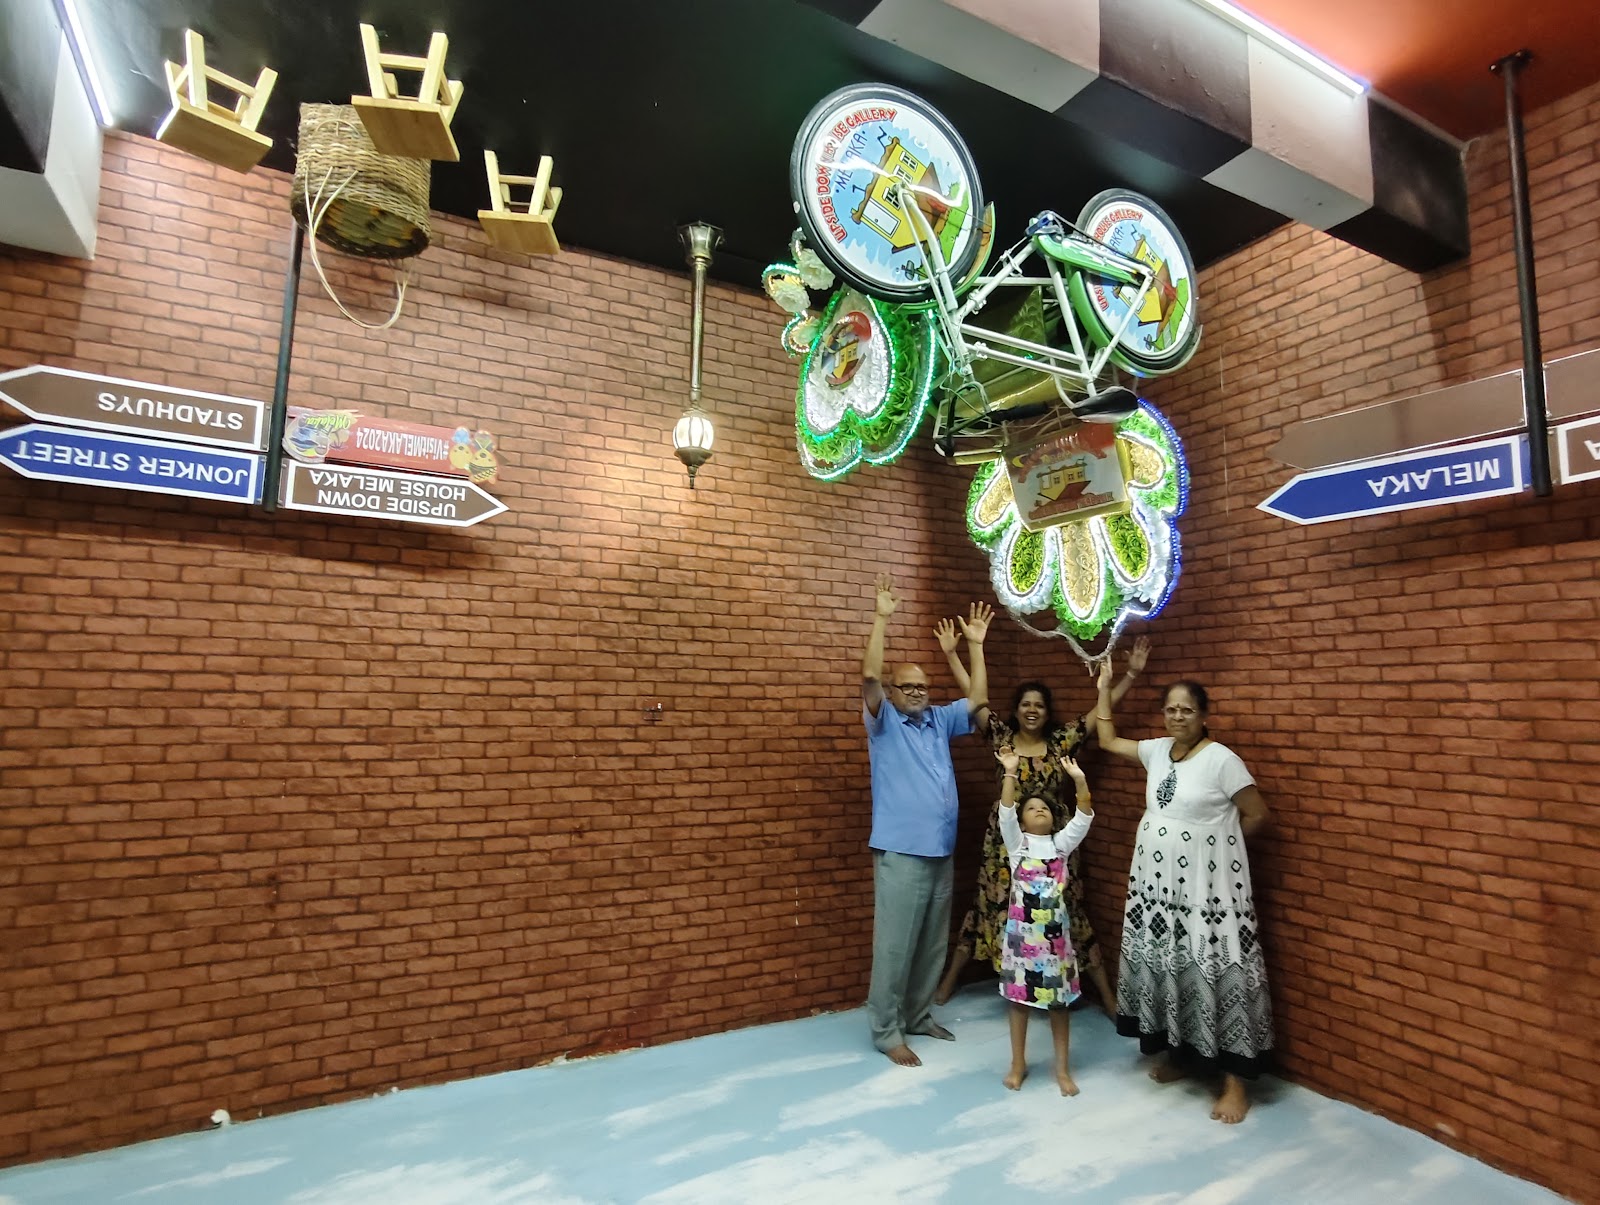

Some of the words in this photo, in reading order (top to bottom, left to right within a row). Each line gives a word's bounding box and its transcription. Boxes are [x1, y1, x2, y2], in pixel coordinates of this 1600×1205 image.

[820, 195, 848, 243] UPSIDE
[846, 107, 897, 128] GALLERY
[836, 133, 868, 192] MEAKA
[1110, 208, 1143, 223] GALLERY
[98, 392, 244, 430] STADHUYS
[305, 413, 351, 430] Melaka
[11, 440, 131, 471] STREET
[356, 427, 450, 460] #VisitMELAKA2024
[138, 456, 249, 486] JONKER
[309, 469, 394, 494] MELAKA
[1366, 457, 1500, 498] MELAKA
[318, 489, 380, 510] DOWN
[399, 480, 466, 501] HOUSE
[386, 498, 456, 518] UPSIDE
